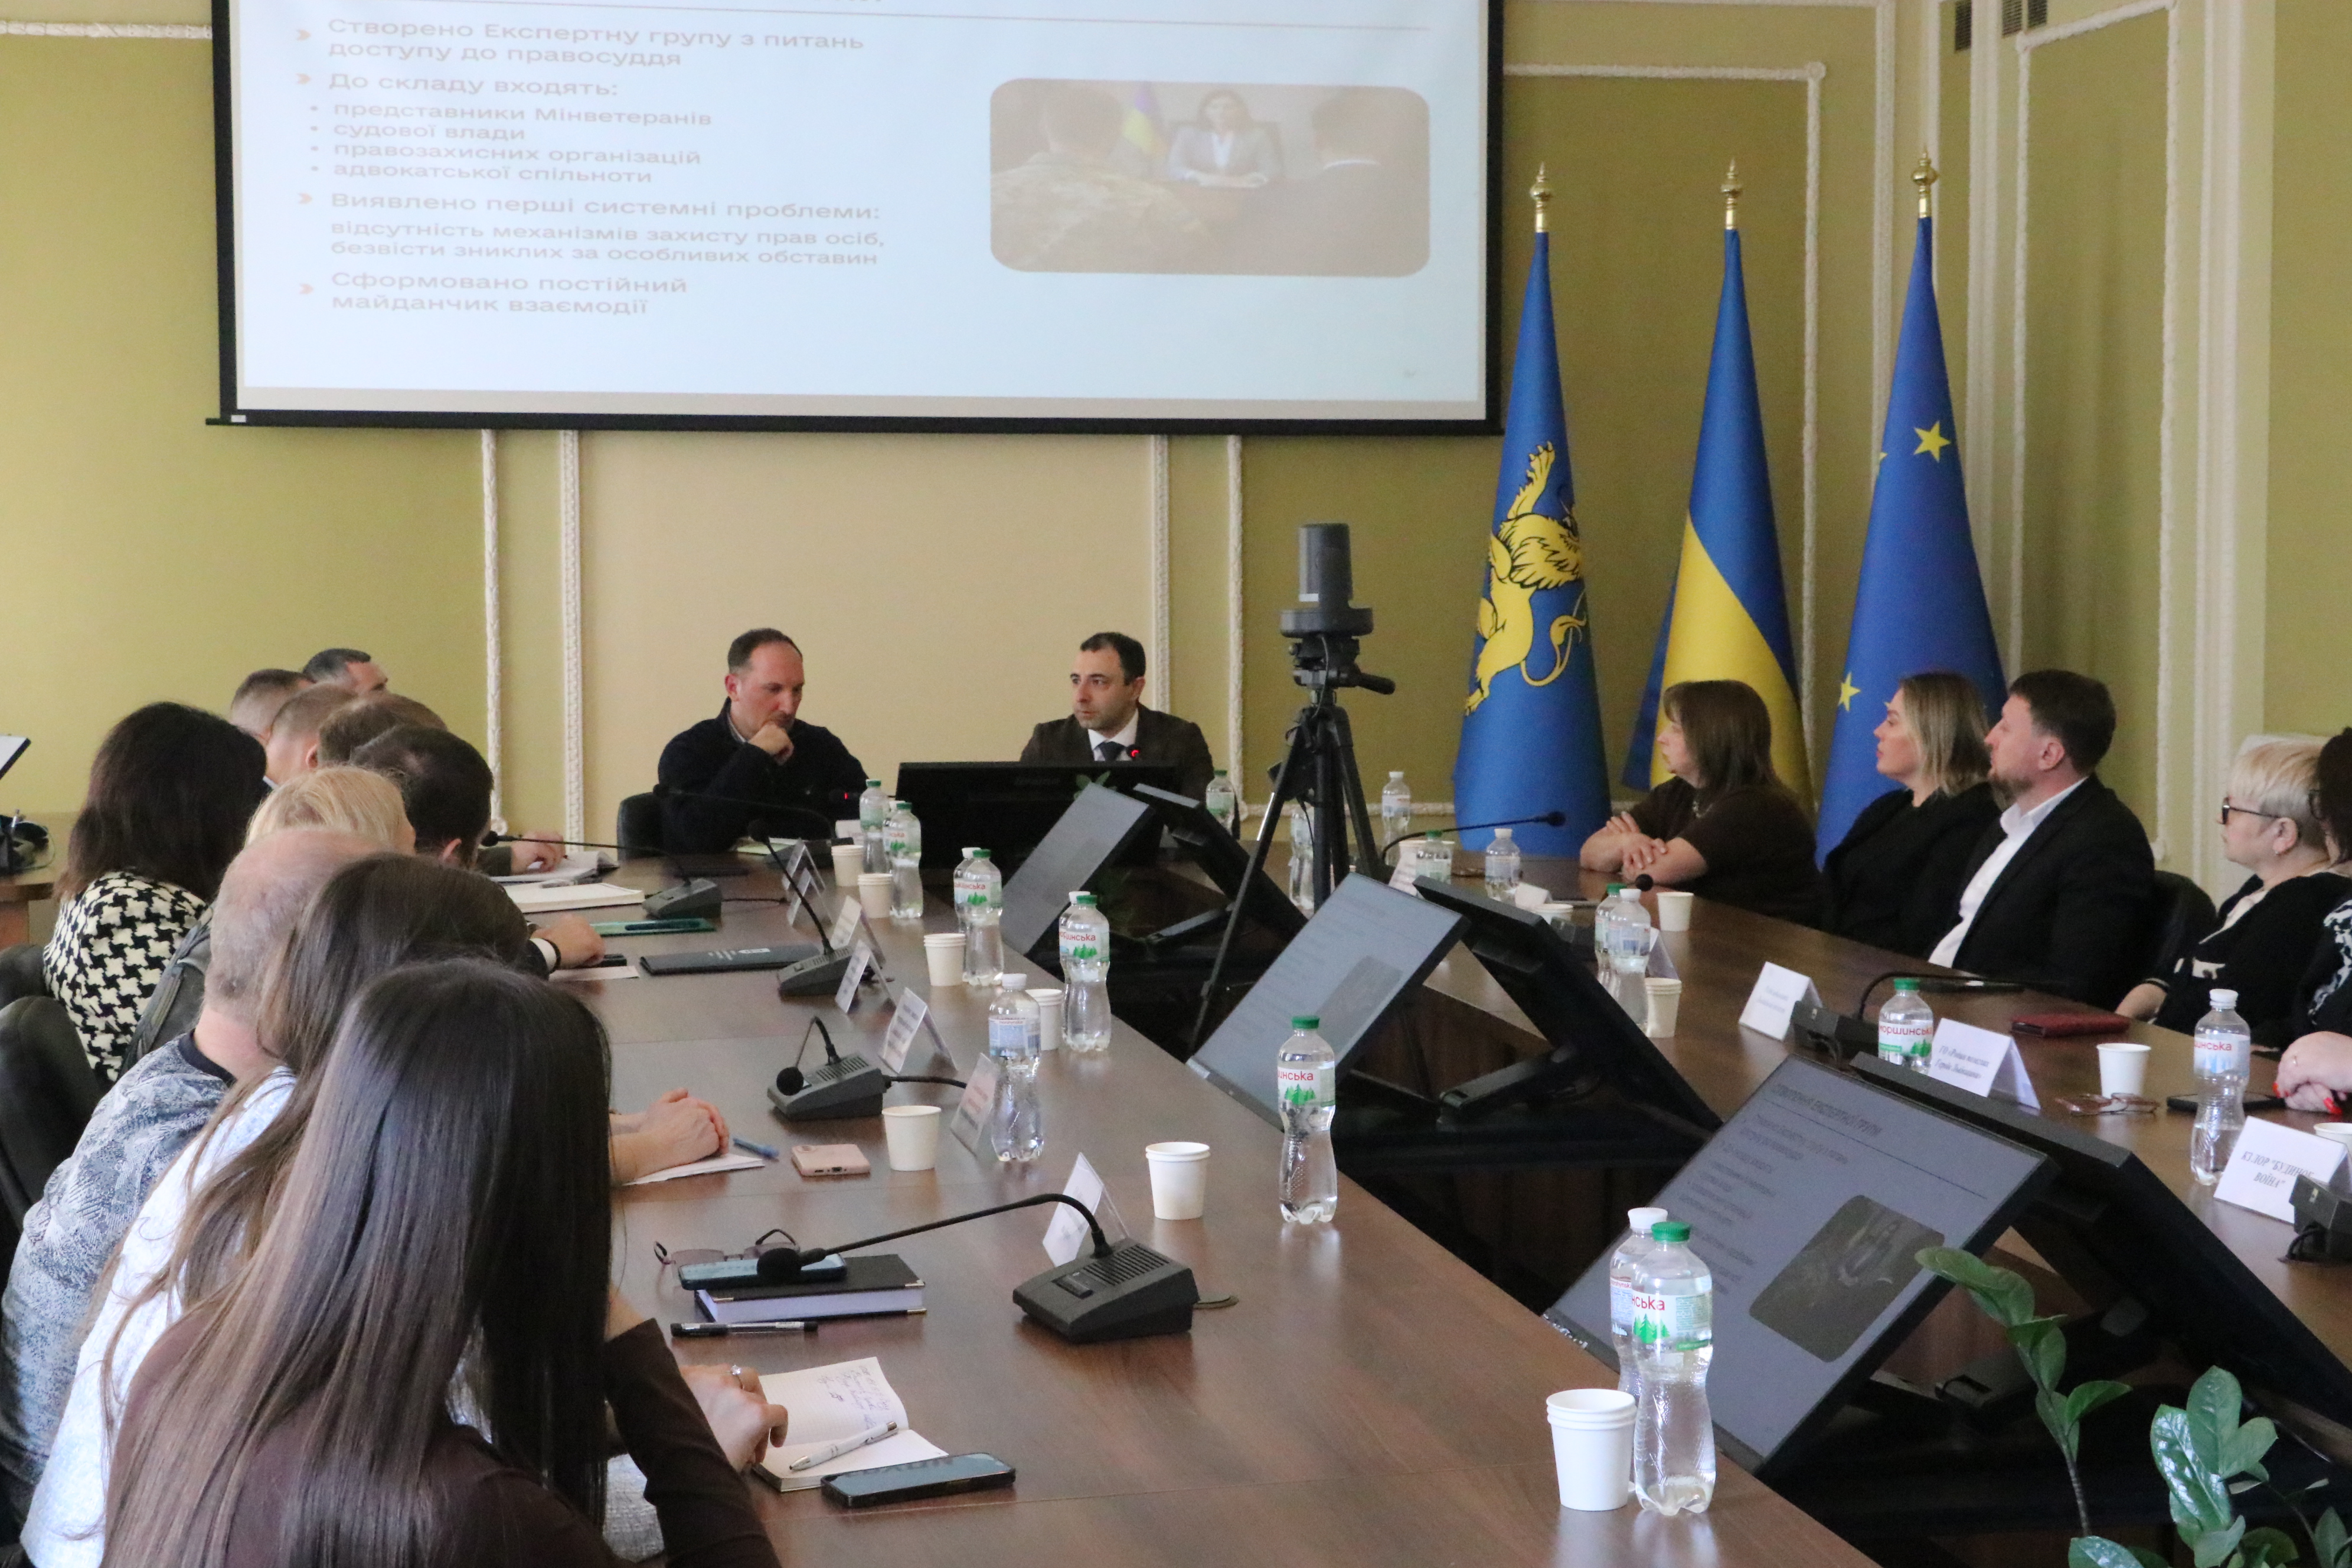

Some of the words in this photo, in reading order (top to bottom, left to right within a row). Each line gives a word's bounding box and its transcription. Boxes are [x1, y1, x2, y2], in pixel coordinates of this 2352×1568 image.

[328, 19, 473, 38] Створено
[485, 24, 639, 45] Експертну
[649, 31, 731, 48] групу
[741, 34, 754, 45] з
[765, 35, 864, 49] питань
[328, 43, 451, 61] доступу
[461, 47, 496, 60] до
[508, 48, 681, 67] правосуддя
[329, 74, 368, 90] До
[379, 76, 484, 93] складу
[495, 81, 618, 96] входять:
[335, 104, 525, 120] представники
[334, 124, 436, 138] судової
[446, 128, 525, 141] влади
[335, 145, 538, 161] правозахисних
[549, 149, 701, 165] організацій
[334, 164, 511, 179] адвокатської
[518, 168, 651, 182] спільноти
[332, 193, 475, 210] Виявлено
[487, 198, 573, 214] перші
[584, 201, 716, 216] системні
[728, 204, 879, 220] проблеми:
[332, 222, 483, 238] відсутність
[494, 227, 638, 241] механізмів
[647, 231, 747, 245] захисту
[757, 233, 816, 246] прав
[825, 232, 884, 247] осіб,
[332, 241, 445, 256] безвісти
[455, 245, 563, 259] зниклих
[572, 249, 599, 259] за
[608, 249, 749, 263] особливих
[758, 250, 877, 265] обставин
[332, 272, 528, 289] Сформовано
[539, 277, 687, 293] постійний
[332, 295, 499, 312] майданчик
[509, 300, 648, 315] взаємодії
